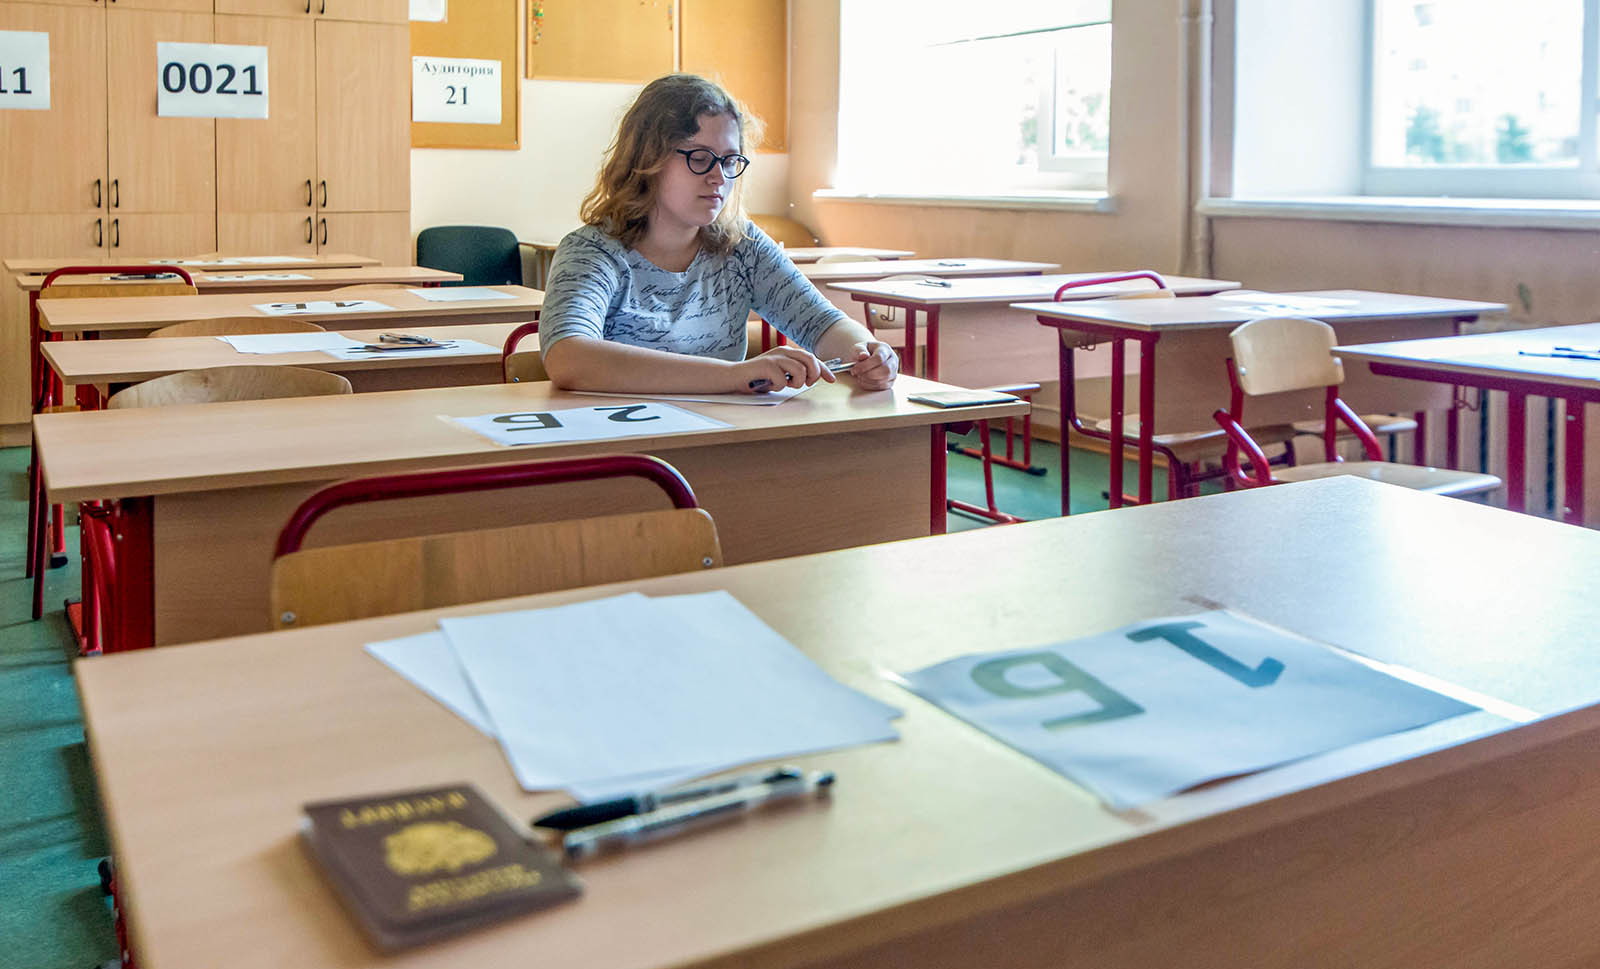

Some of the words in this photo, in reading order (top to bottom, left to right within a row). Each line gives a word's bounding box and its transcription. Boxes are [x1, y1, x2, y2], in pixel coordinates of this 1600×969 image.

[163, 62, 263, 95] 0021
[421, 61, 494, 77] Аудитория
[445, 85, 469, 105] 21
